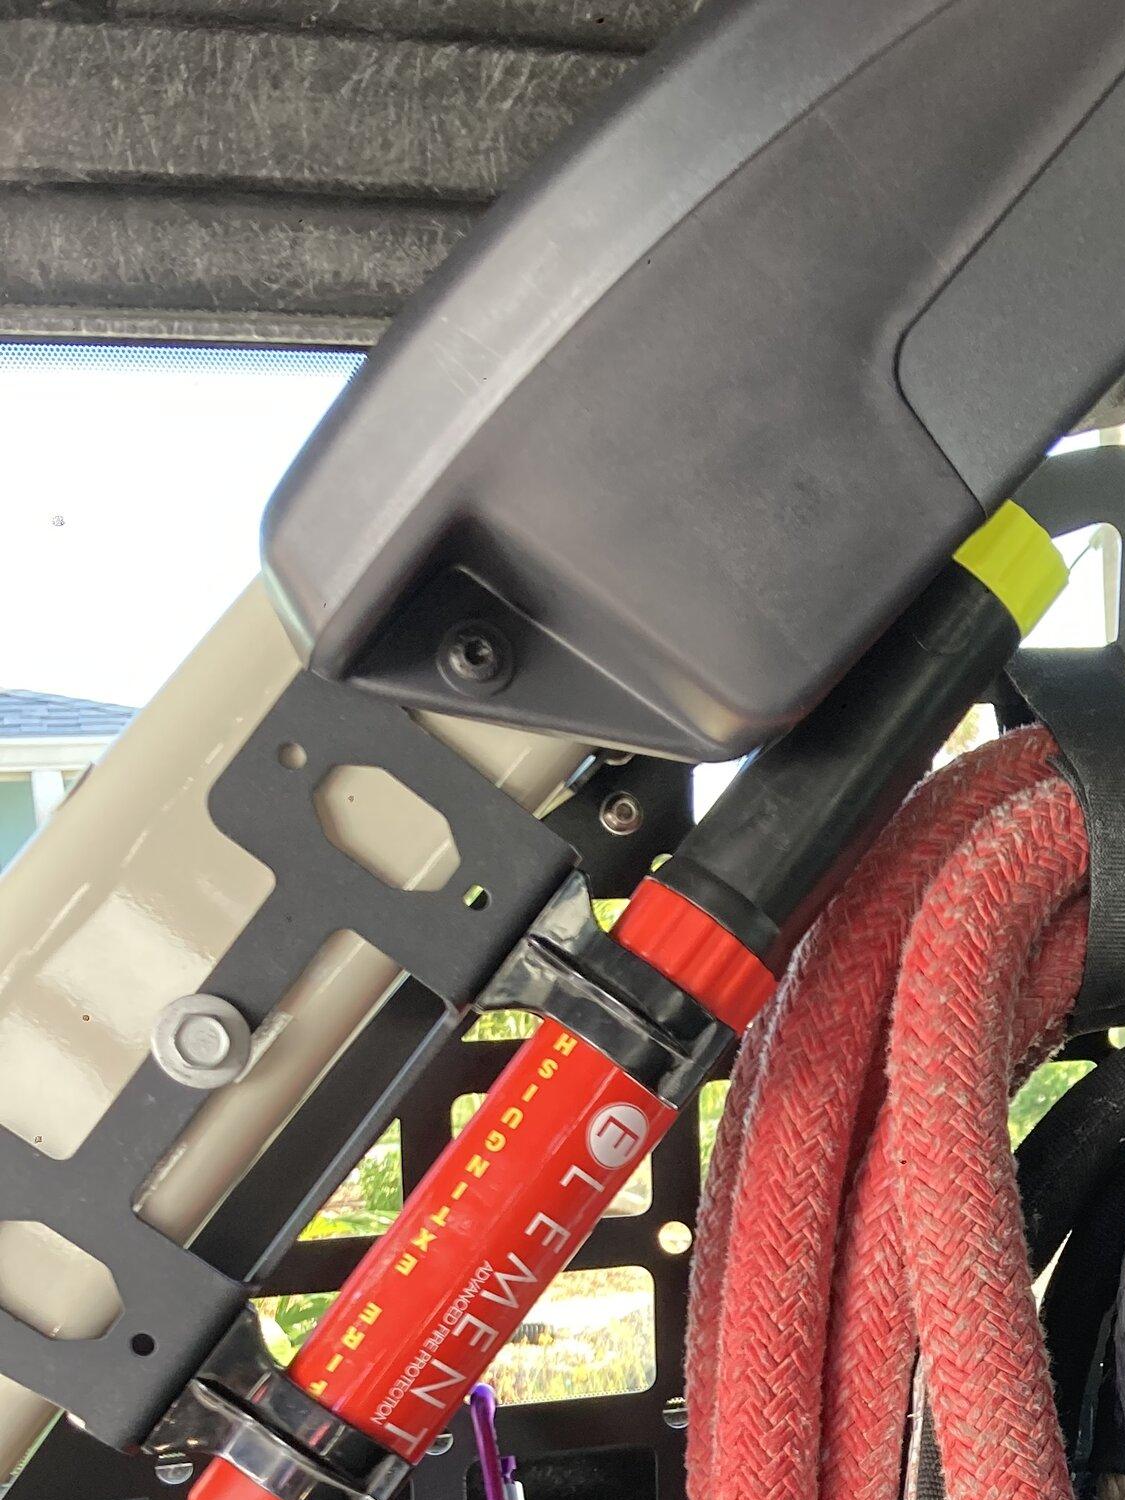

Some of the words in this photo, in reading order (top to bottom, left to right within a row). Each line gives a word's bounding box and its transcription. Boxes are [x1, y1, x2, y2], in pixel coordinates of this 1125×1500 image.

[382, 1103, 649, 1456] ELEMENT
[441, 1260, 494, 1326] ADVANCED
[423, 1322, 450, 1353] FIRE
[370, 1349, 432, 1426] PROTECTION
